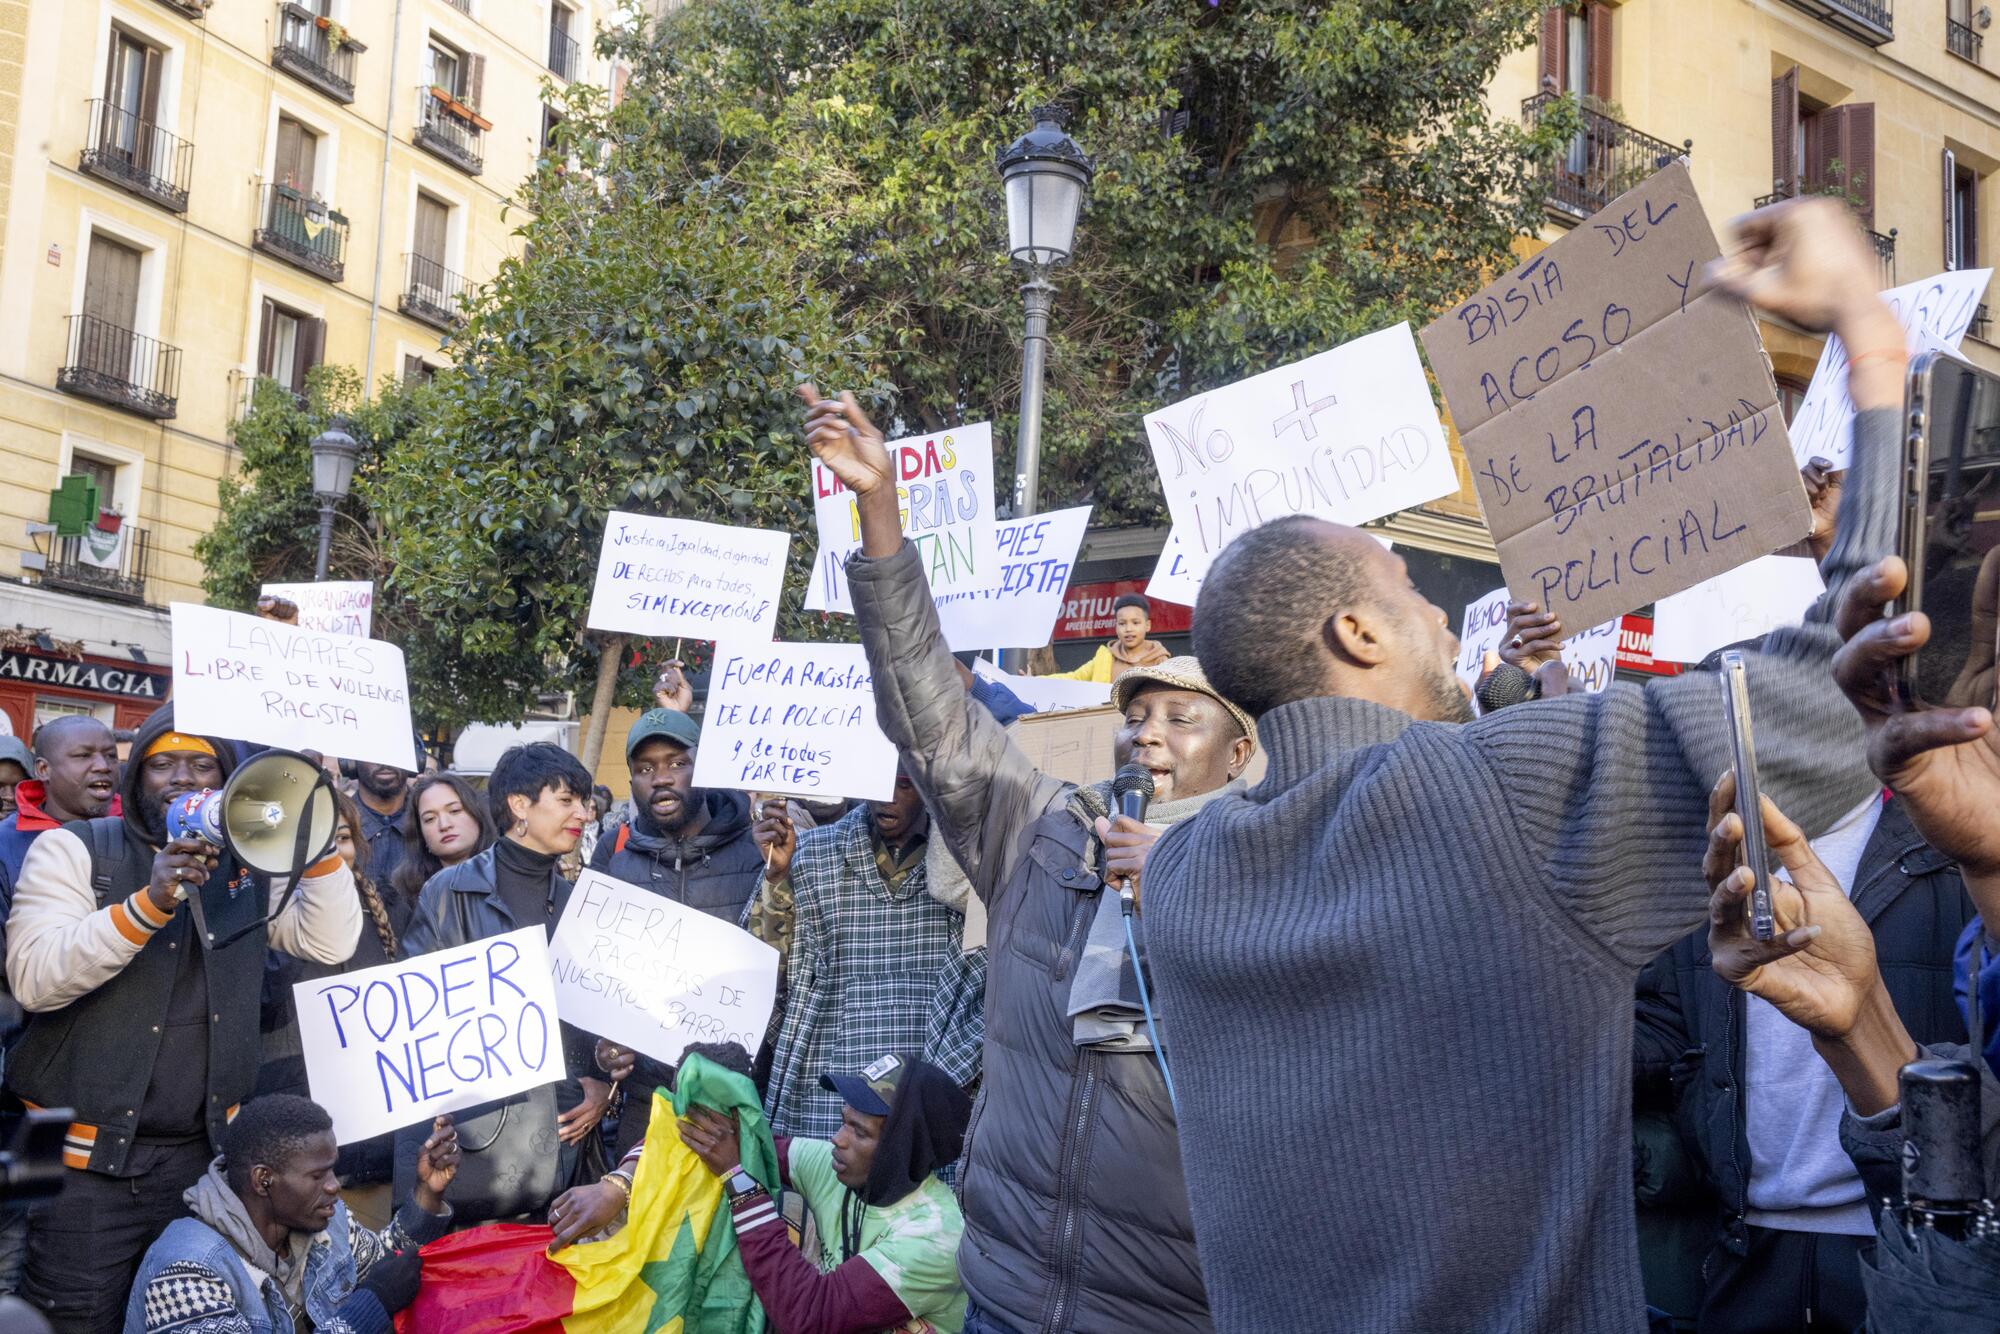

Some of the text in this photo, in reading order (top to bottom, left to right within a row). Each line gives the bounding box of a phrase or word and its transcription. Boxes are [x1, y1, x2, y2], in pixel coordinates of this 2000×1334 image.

[1458, 200, 1679, 345] BASTA DEL
[1480, 260, 1694, 414] ACOSO Y
[889, 435, 957, 482] IDAS
[1480, 405, 1598, 506] DE LA
[849, 468, 979, 543] GRAS
[996, 521, 1052, 557] PIES
[687, 573, 712, 589] para
[823, 526, 975, 603] IMTAN
[0, 653, 155, 697] ARMACIA
[286, 671, 320, 689] DE
[716, 703, 743, 727] DE
[749, 705, 772, 726] LA
[750, 737, 773, 759] de
[741, 760, 821, 787] PARTES
[577, 880, 682, 961] FUERA
[317, 941, 527, 1049] PODER
[587, 934, 746, 1008] RACISTAS DE
[376, 1001, 548, 1113] NEGRO
